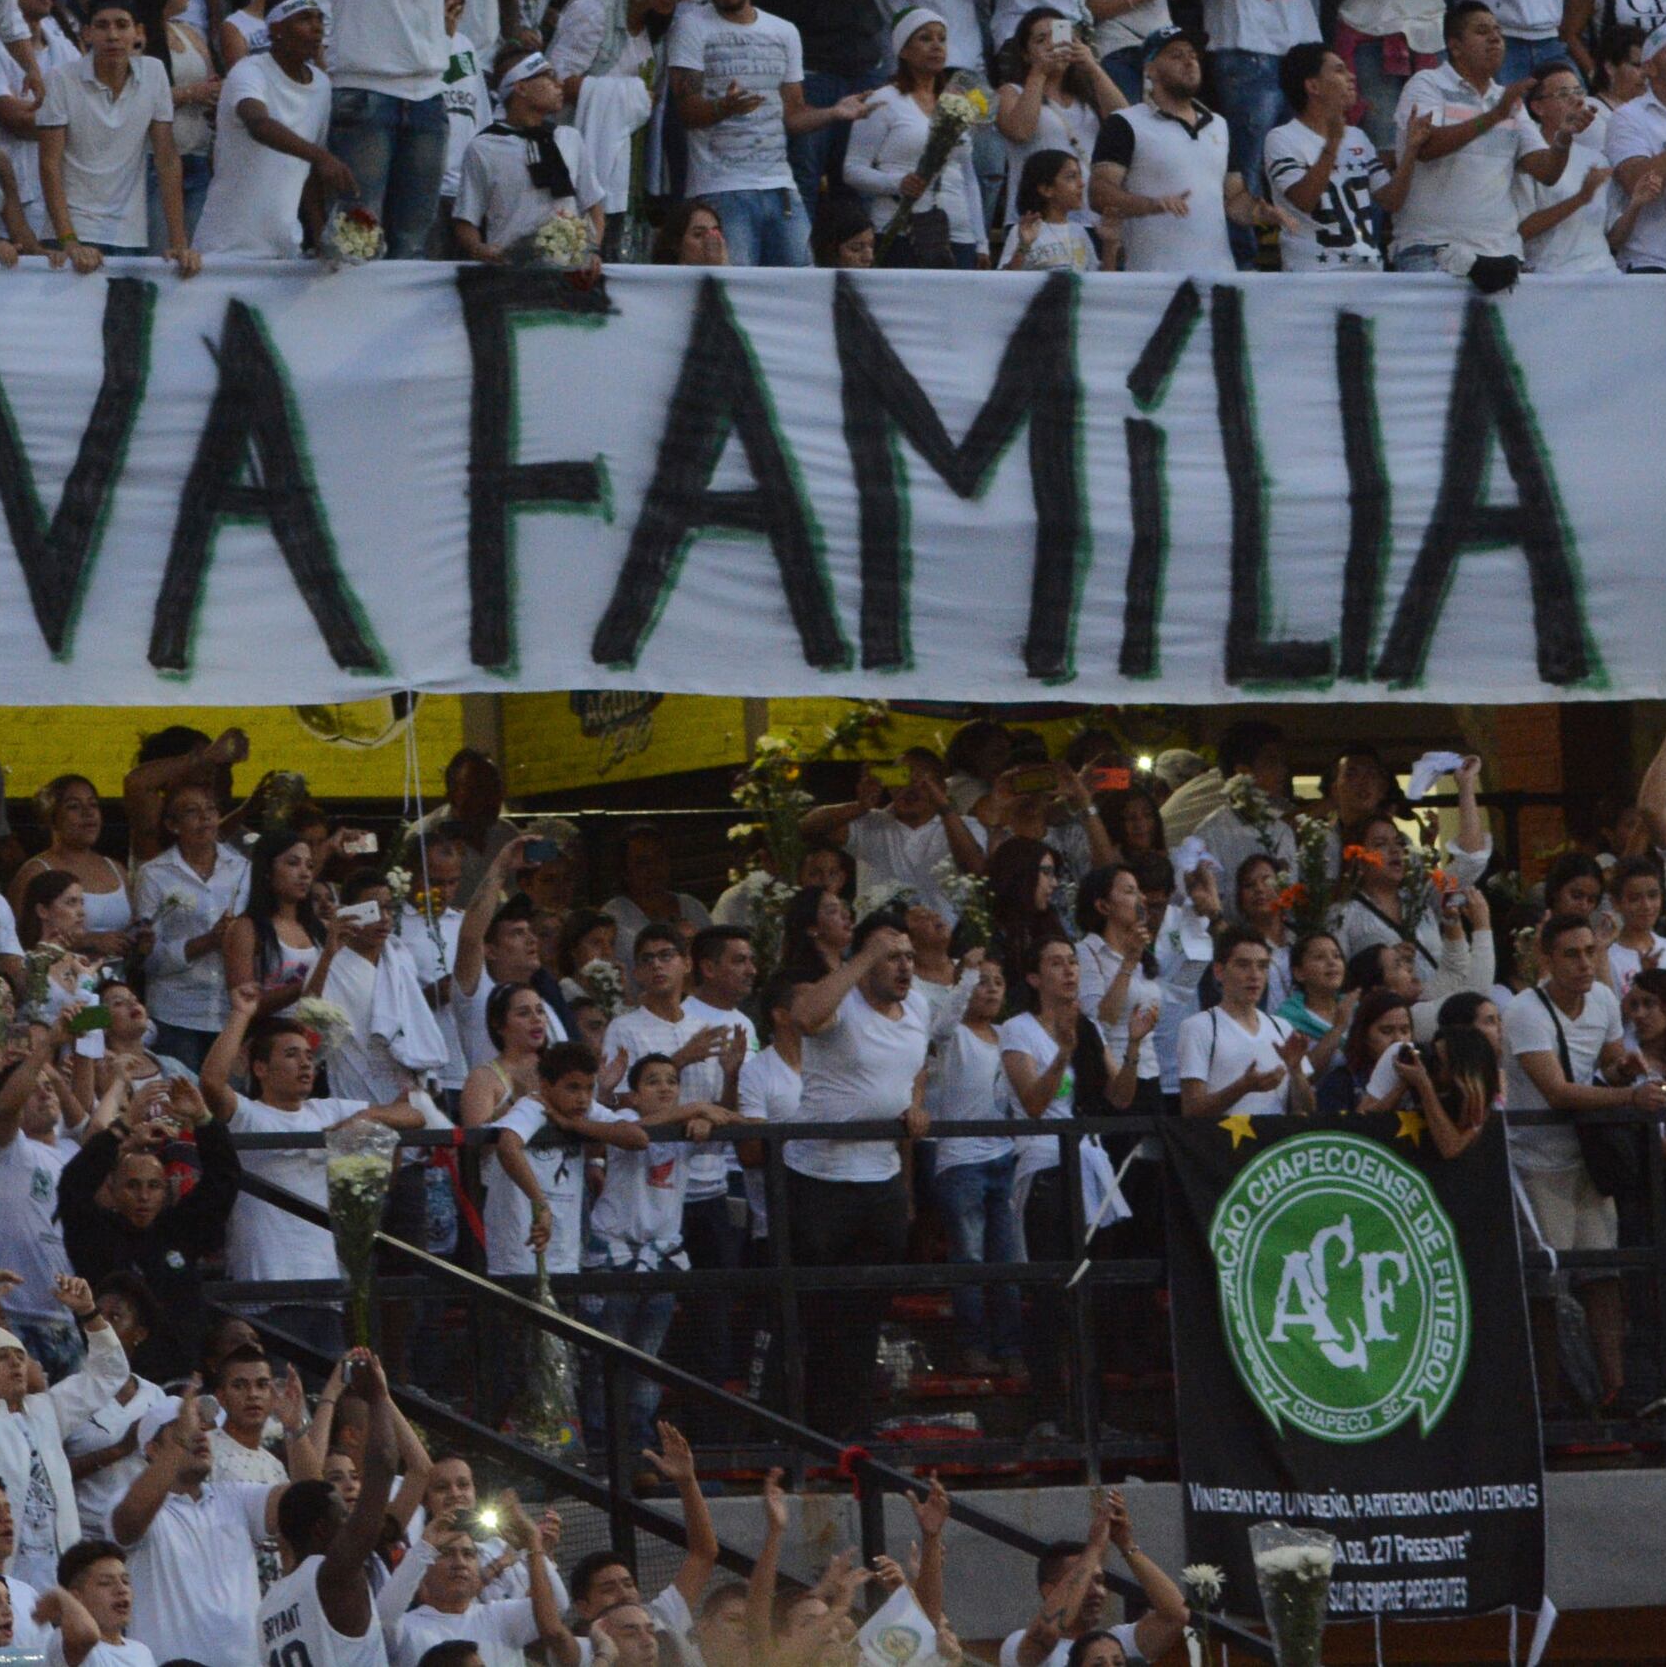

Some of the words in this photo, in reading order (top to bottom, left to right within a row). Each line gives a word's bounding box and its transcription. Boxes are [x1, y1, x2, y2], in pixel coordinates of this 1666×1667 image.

[1246, 1146, 1424, 1217] CHAPECOENSE
[1411, 1209, 1447, 1257] DE
[1265, 1213, 1411, 1374] ACF
[1416, 1258, 1457, 1397] FUTEBOL
[1188, 1481, 1255, 1516] VINIERON
[1254, 1487, 1282, 1516] POR
[1353, 1491, 1432, 1518] PARTIERON
[1431, 1486, 1475, 1514] COMO
[1474, 1482, 1539, 1512] LEYENDAS
[1346, 1539, 1372, 1565] DEL
[1371, 1534, 1394, 1566] 27
